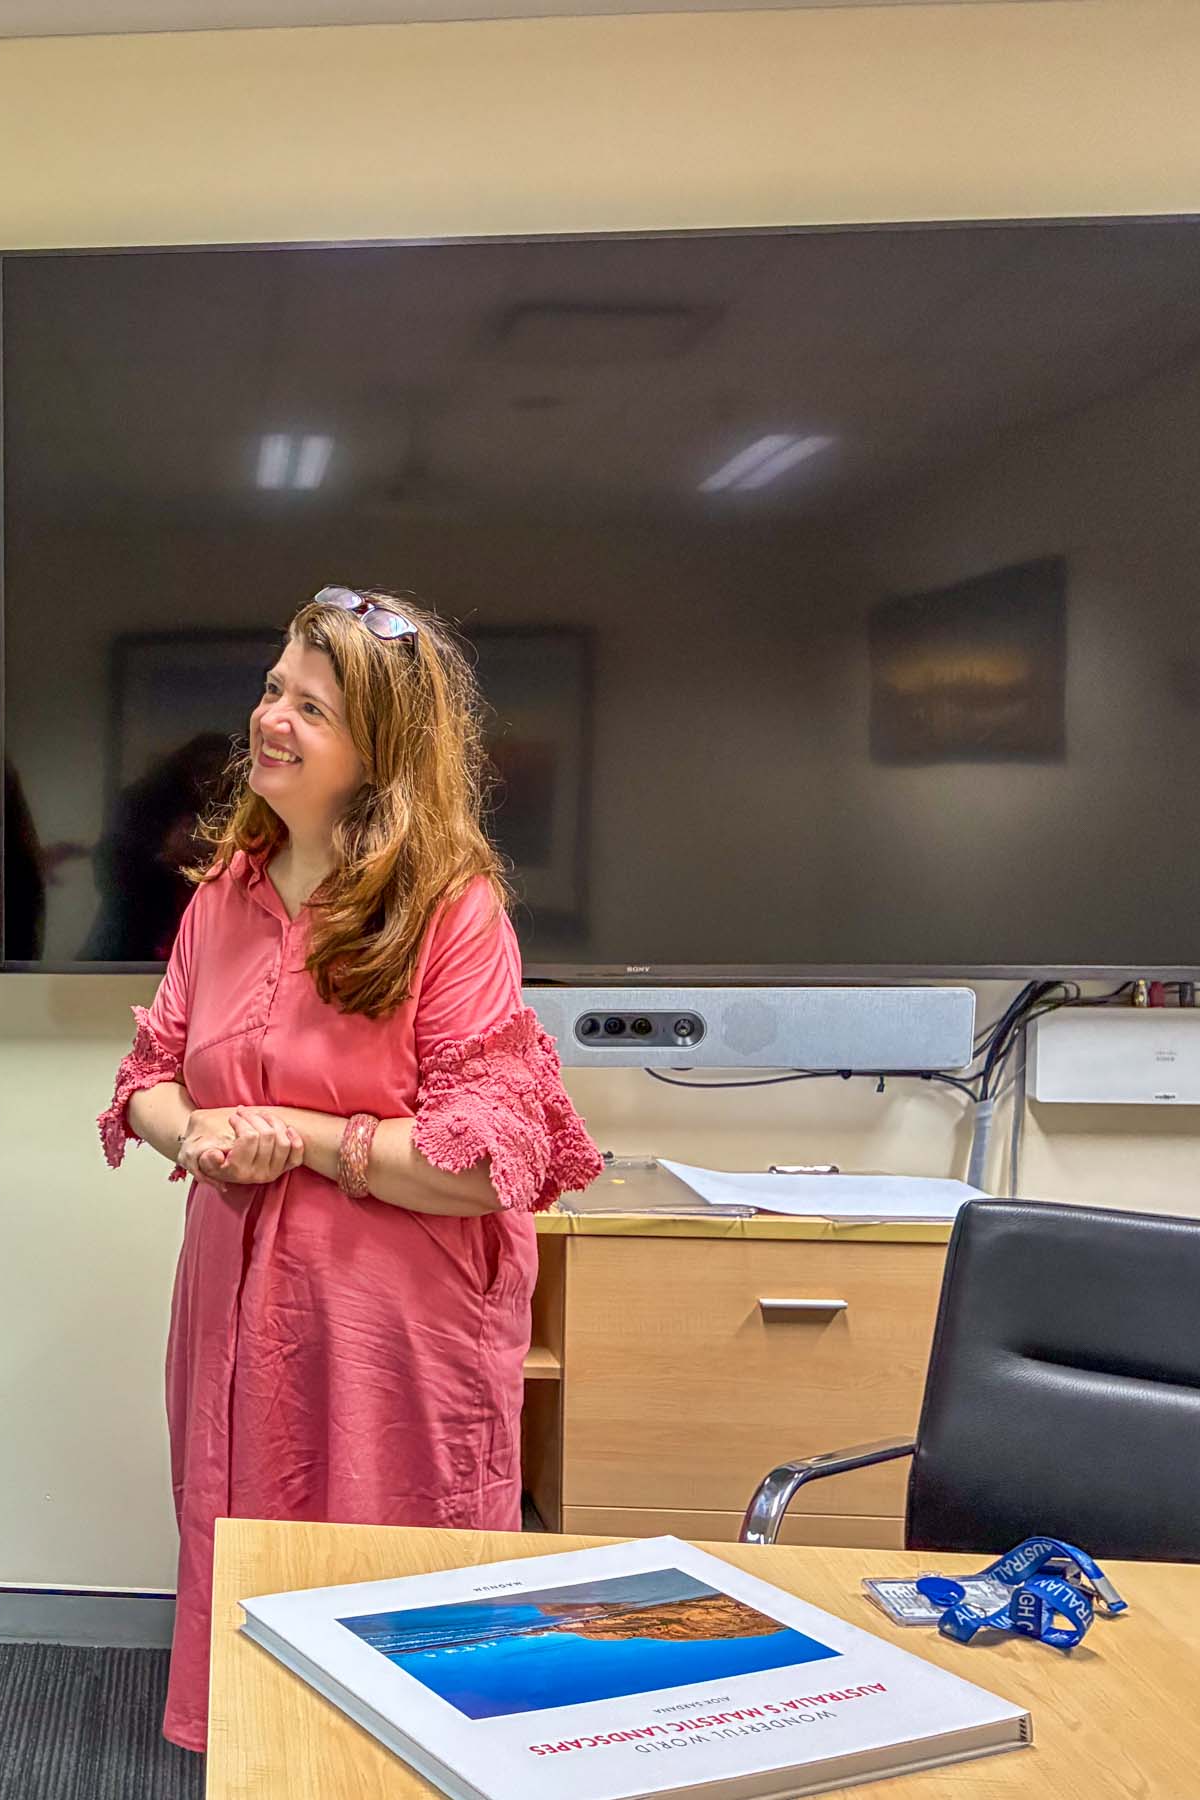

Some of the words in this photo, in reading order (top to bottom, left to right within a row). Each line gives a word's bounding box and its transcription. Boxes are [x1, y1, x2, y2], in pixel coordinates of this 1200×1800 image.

[472, 1581, 523, 1592] MAGNUM
[1034, 1579, 1092, 1628] TRALIAN
[655, 1700, 706, 1714] SARDANA
[707, 1695, 731, 1706] ALOK
[766, 1682, 888, 1713] AUSTRALIA'S
[667, 1706, 765, 1733] MAJESTIC
[712, 1709, 838, 1740] WONDERFUL
[528, 1726, 669, 1756] LANDSCAPES
[635, 1735, 711, 1754] WORLD
